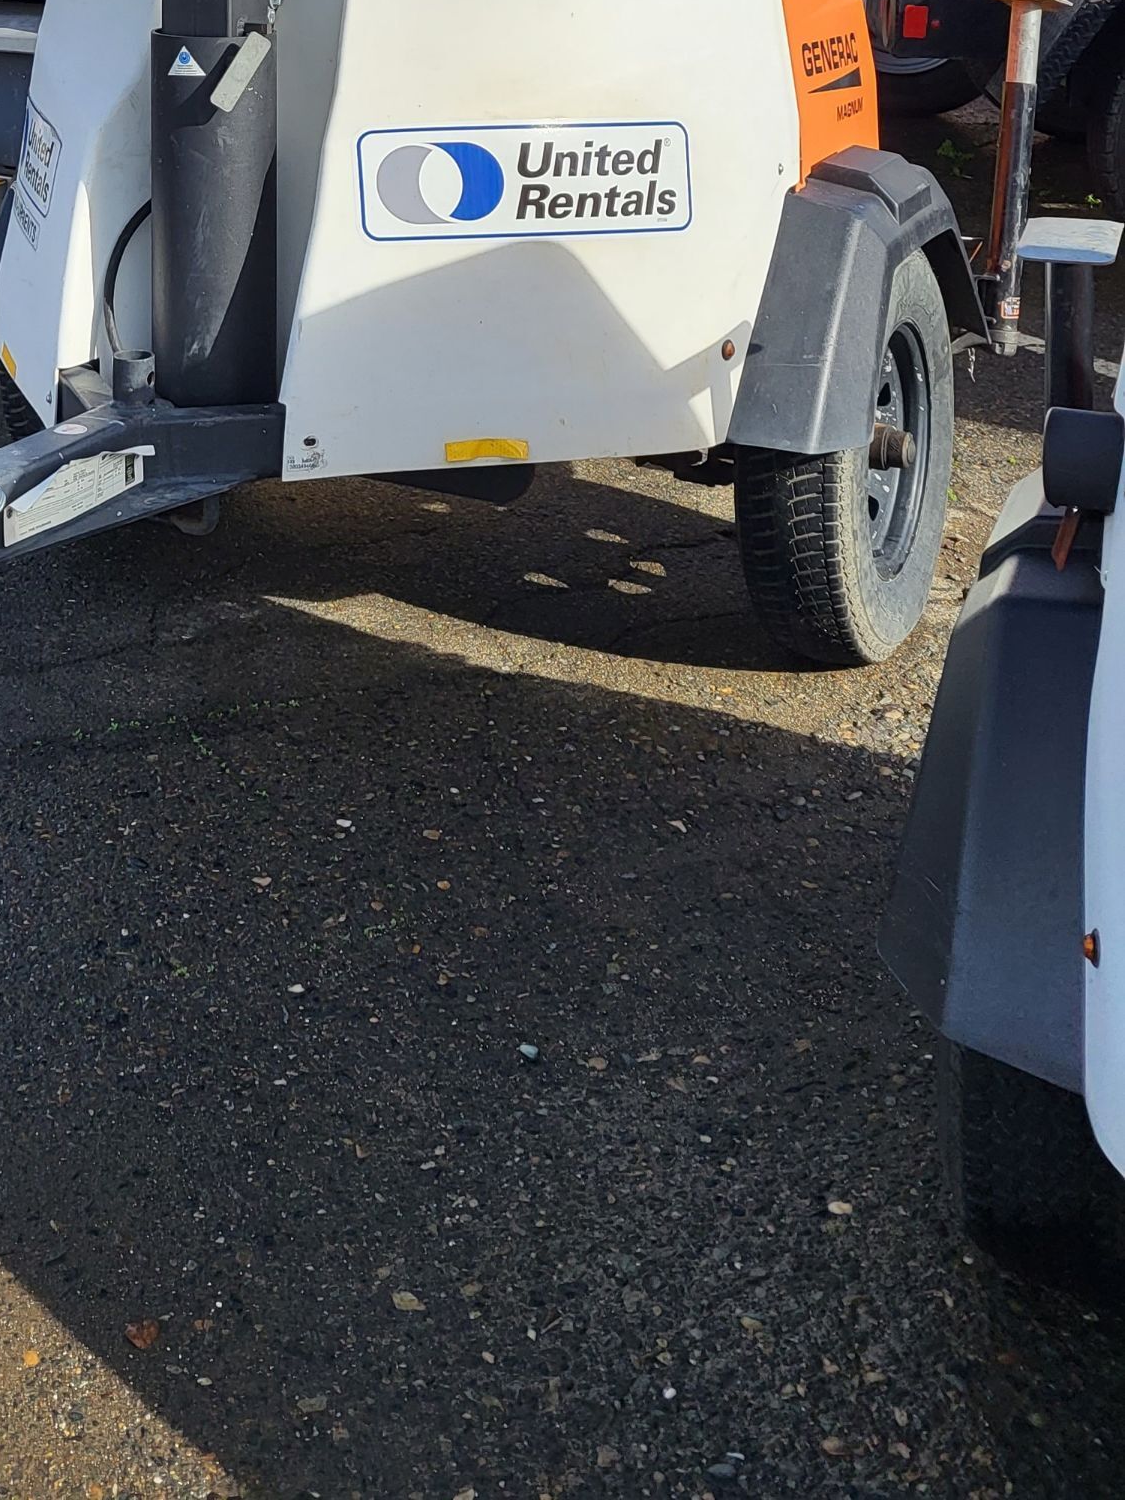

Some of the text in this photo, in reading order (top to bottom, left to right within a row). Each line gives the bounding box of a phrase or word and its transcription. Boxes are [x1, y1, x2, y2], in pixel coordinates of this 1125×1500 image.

[801, 32, 859, 77] GENERAC
[836, 97, 864, 122] MAGNUM
[27, 118, 55, 169] United
[516, 139, 663, 179] United
[24, 150, 51, 204] Rentals
[515, 180, 677, 221] Rentals
